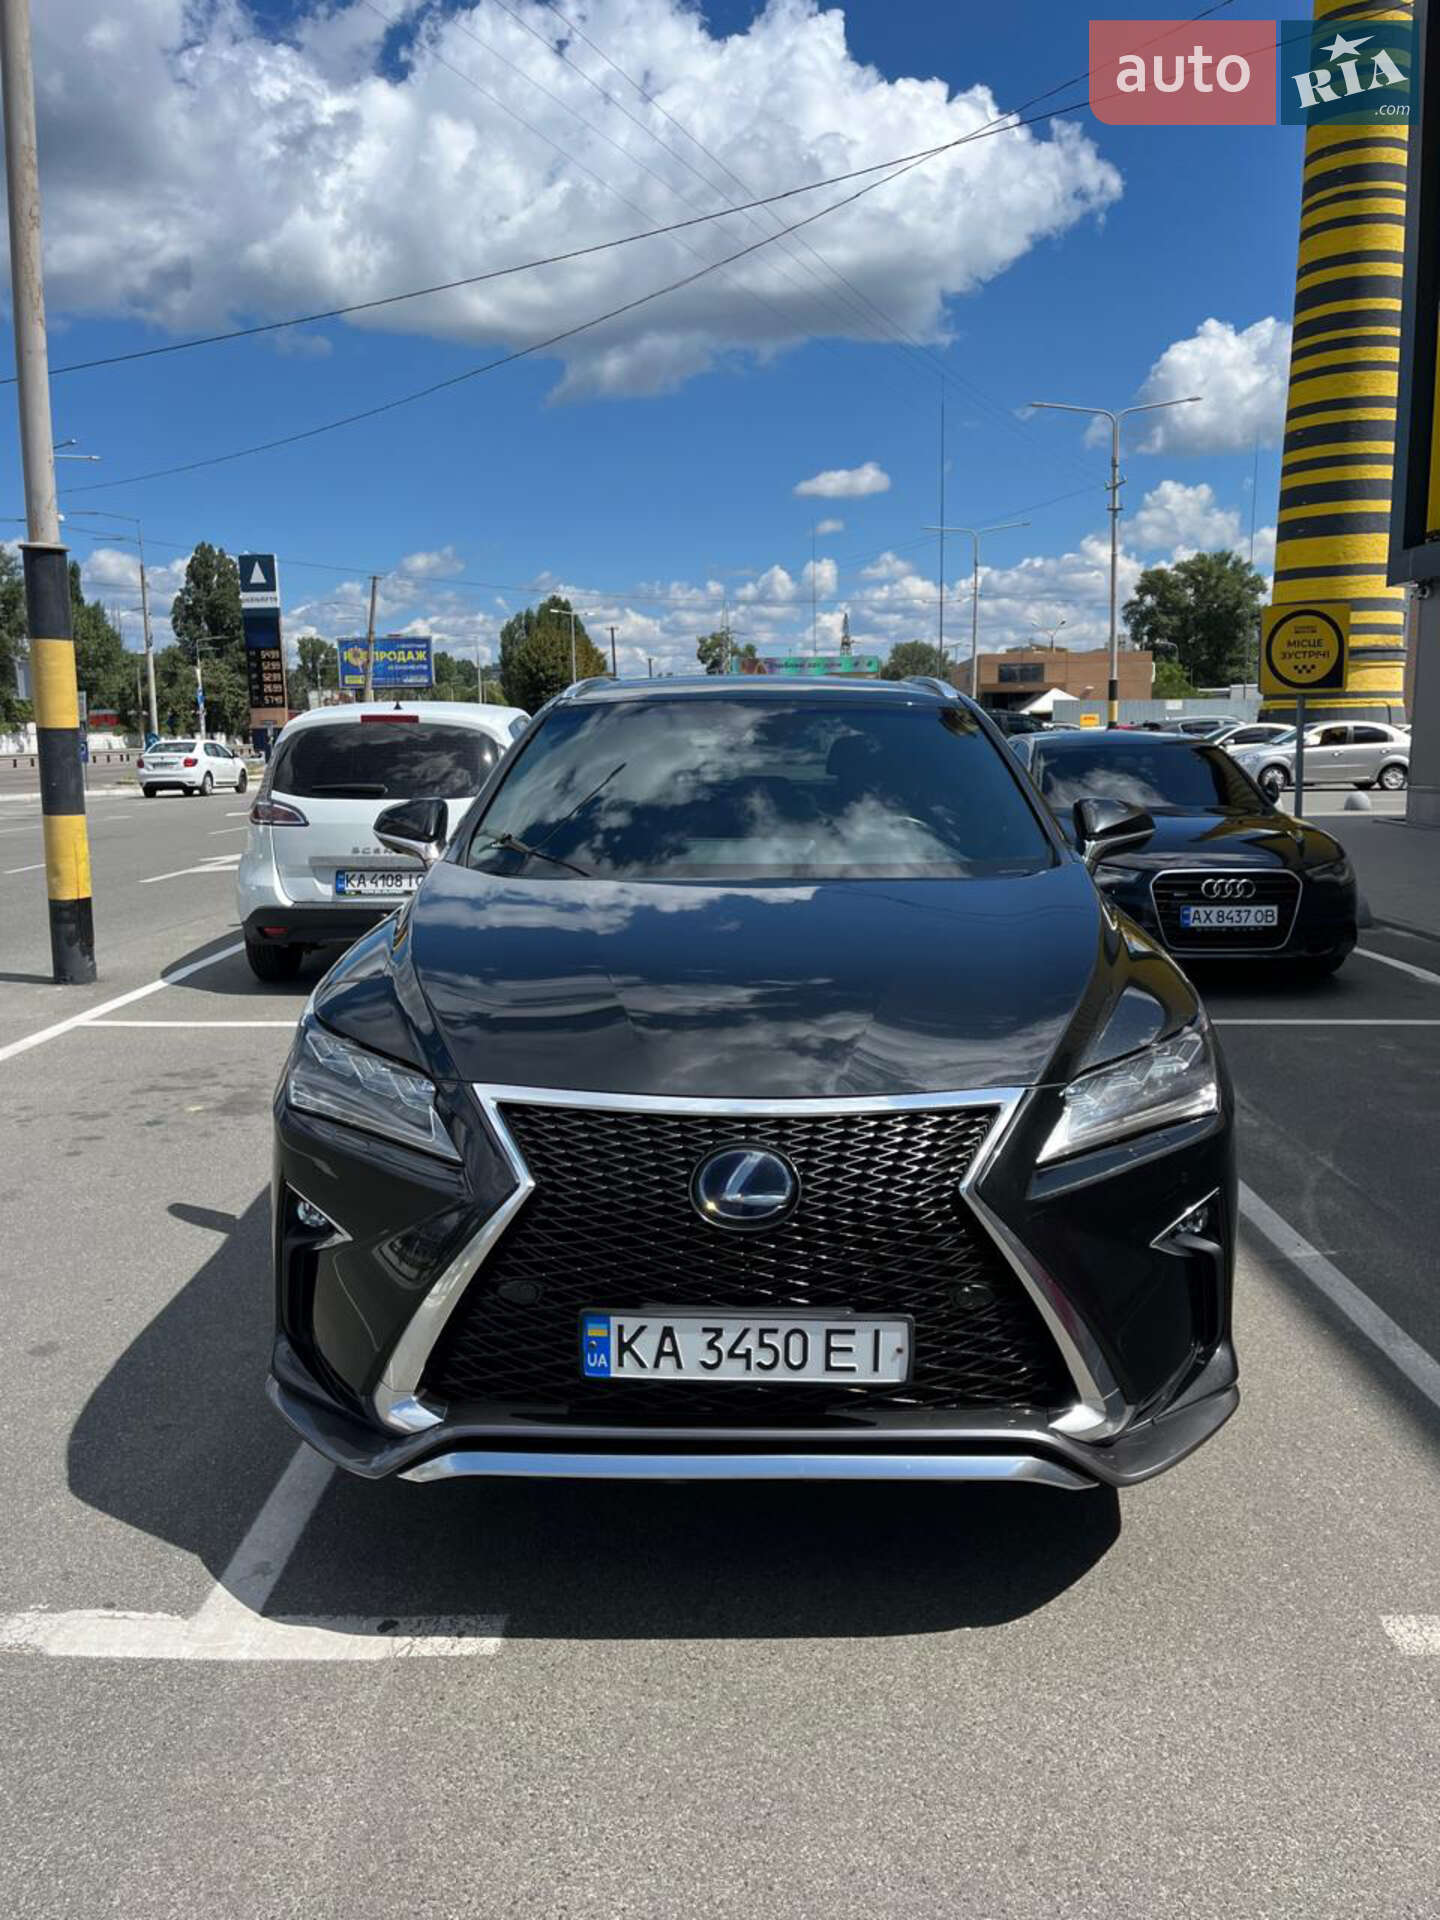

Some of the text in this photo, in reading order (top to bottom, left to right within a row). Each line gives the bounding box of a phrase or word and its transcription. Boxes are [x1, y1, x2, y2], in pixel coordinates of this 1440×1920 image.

[1286, 639, 1323, 648] МІСЦЕ
[345, 874, 367, 888] KA
[369, 874, 403, 888] 4108
[1191, 909, 1216, 923] AX
[1216, 909, 1251, 923] 8437
[587, 1324, 880, 1373] UA KA 3450 EI
